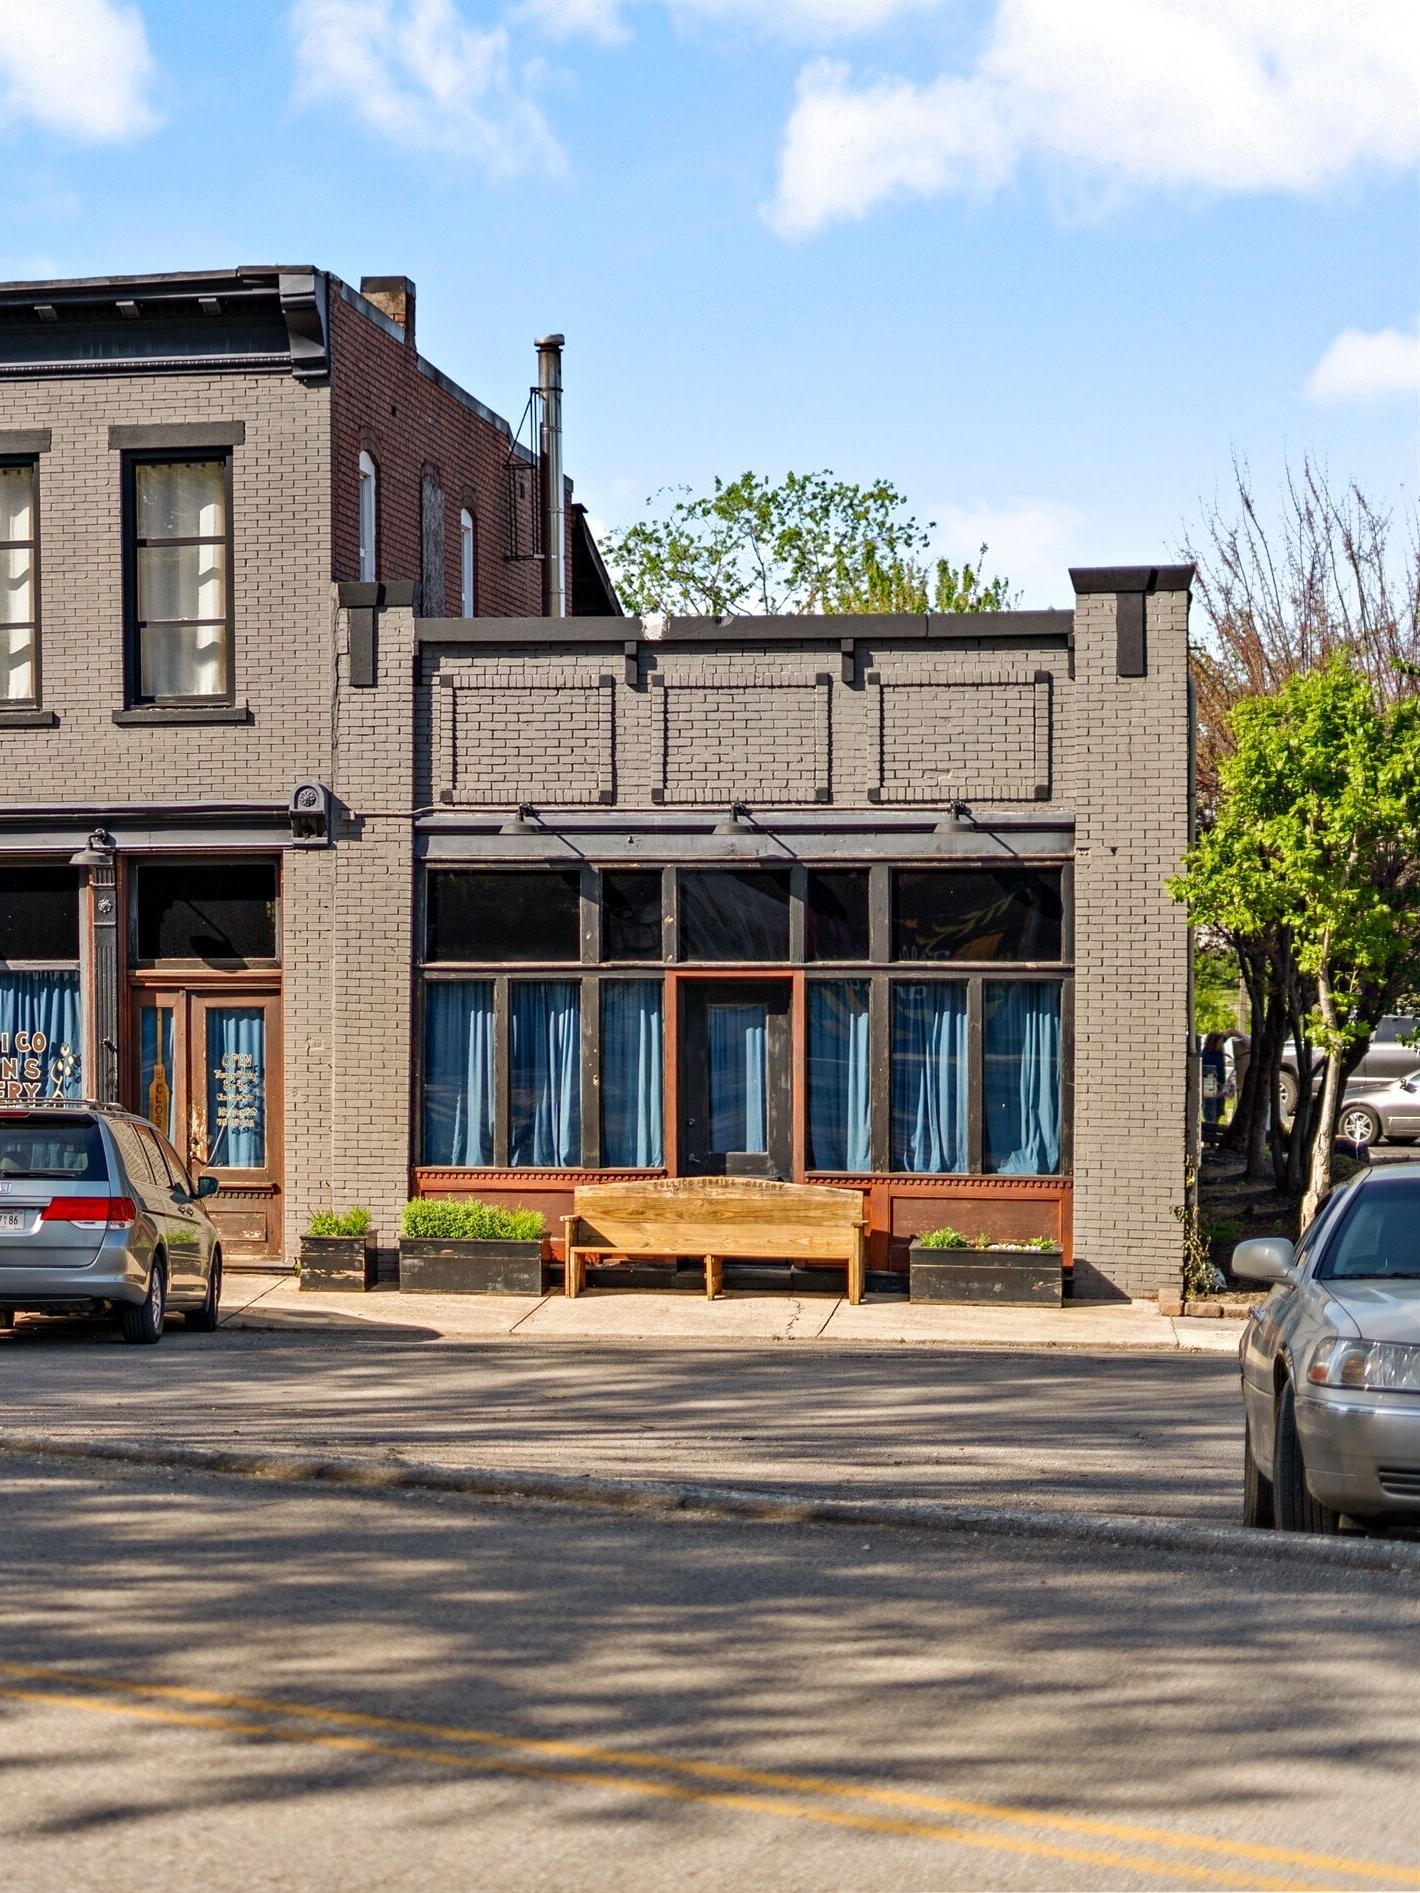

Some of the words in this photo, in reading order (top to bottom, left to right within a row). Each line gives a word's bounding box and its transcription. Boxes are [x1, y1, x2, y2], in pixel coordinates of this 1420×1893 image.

[221, 1052, 252, 1068] OPEN
[155, 1083, 163, 1128] CLOS
[653, 1179, 694, 1190] TELLICO
[701, 1178, 736, 1187] GRAINS
[745, 1180, 786, 1192] BAKERY
[8, 1215, 19, 1225] 86
